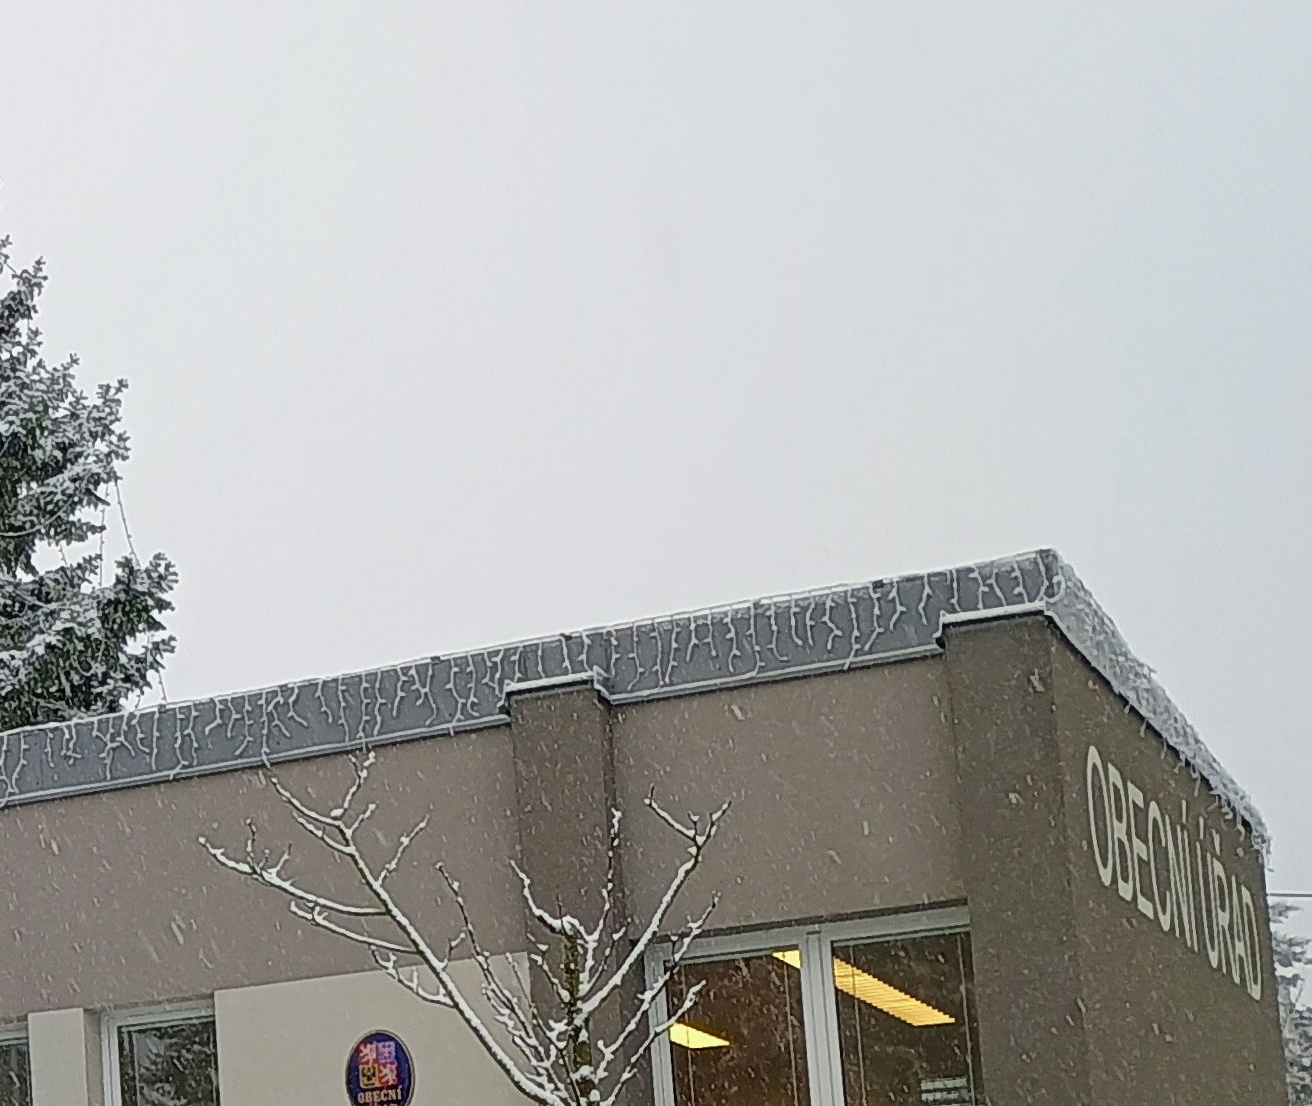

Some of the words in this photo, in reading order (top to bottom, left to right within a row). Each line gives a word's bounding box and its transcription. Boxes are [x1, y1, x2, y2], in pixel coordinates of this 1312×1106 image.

[1086, 745, 1199, 953] OBECNÍ
[1196, 816, 1261, 1001] ÚŘAD
[357, 1085, 403, 1103] OBECNÍ
